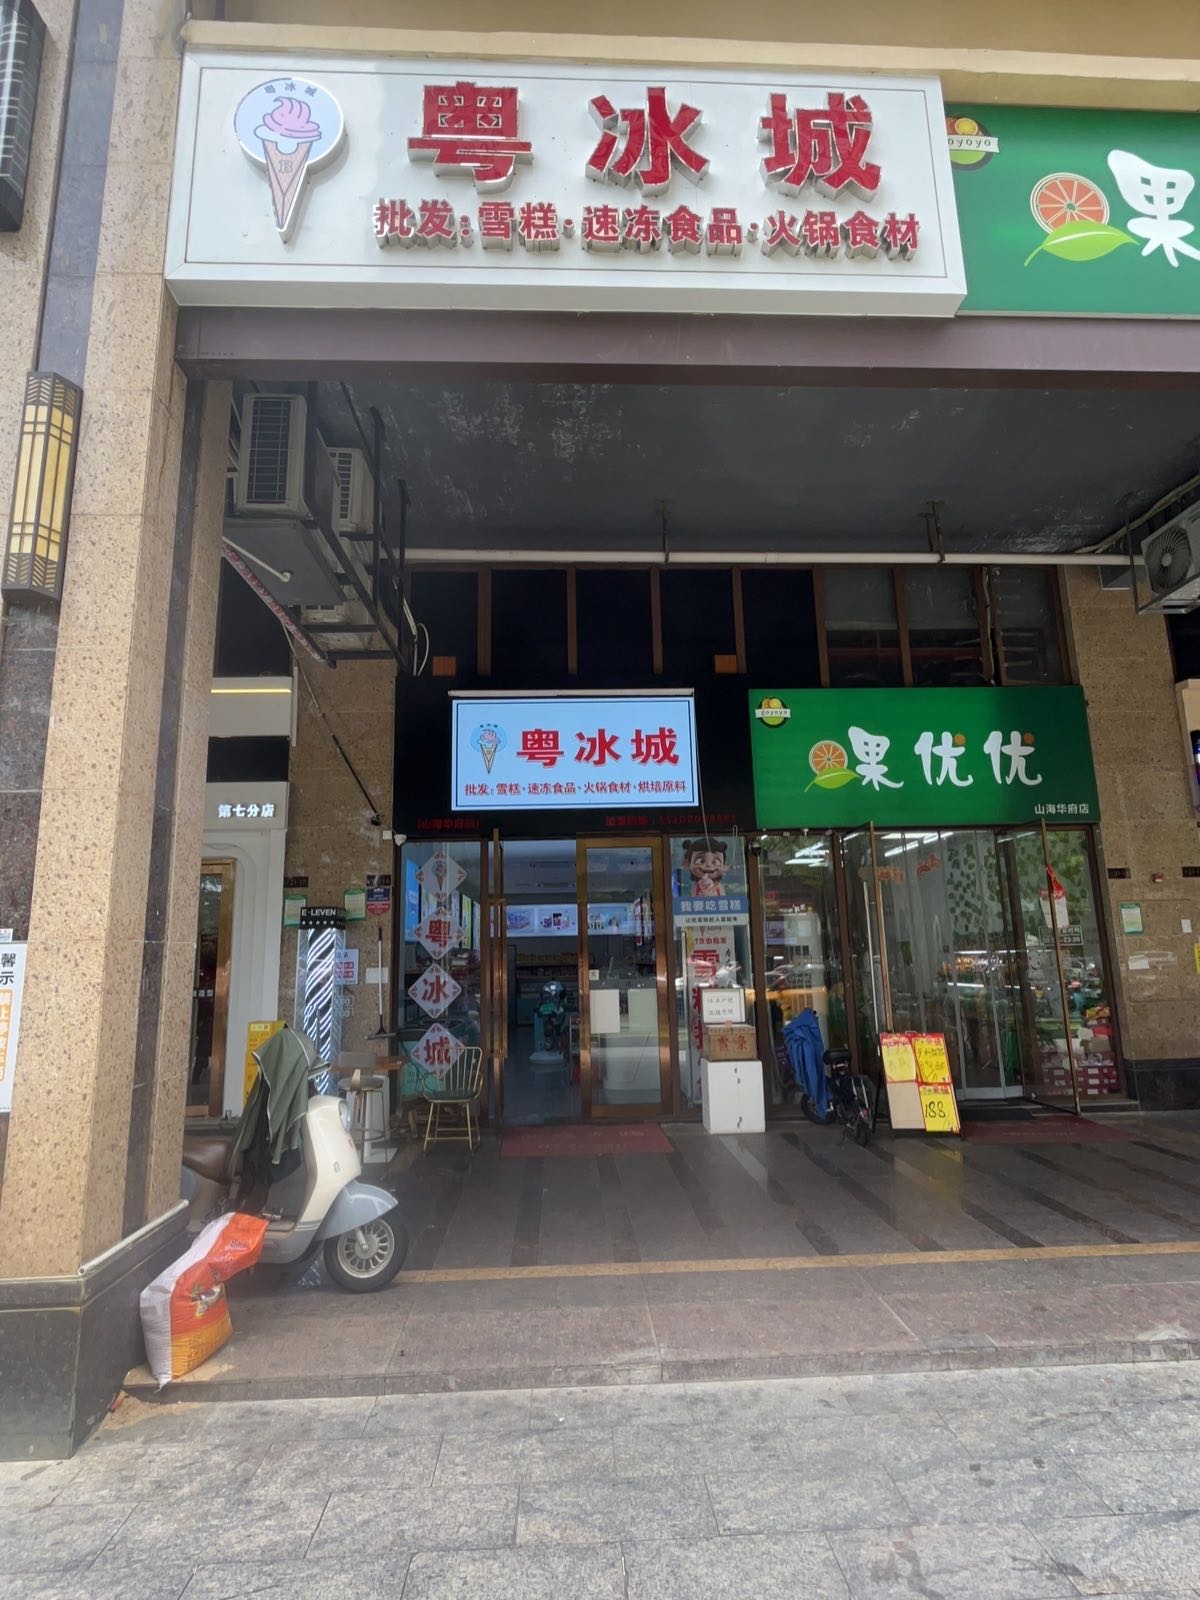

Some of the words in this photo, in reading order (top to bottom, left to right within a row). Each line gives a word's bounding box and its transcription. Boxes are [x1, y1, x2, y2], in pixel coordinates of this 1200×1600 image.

[407, 81, 882, 194] 粤冰城
[1107, 149, 1200, 267] 果
[516, 727, 680, 767] 粤冰城
[848, 726, 1043, 791] 果优优
[218, 804, 275, 818] 第七分店
[1034, 803, 1090, 815] 山海华府店
[680, 899, 742, 912] 我要吃雪糕
[0, 971, 14, 985] 示
[925, 1101, 946, 1118] 188
